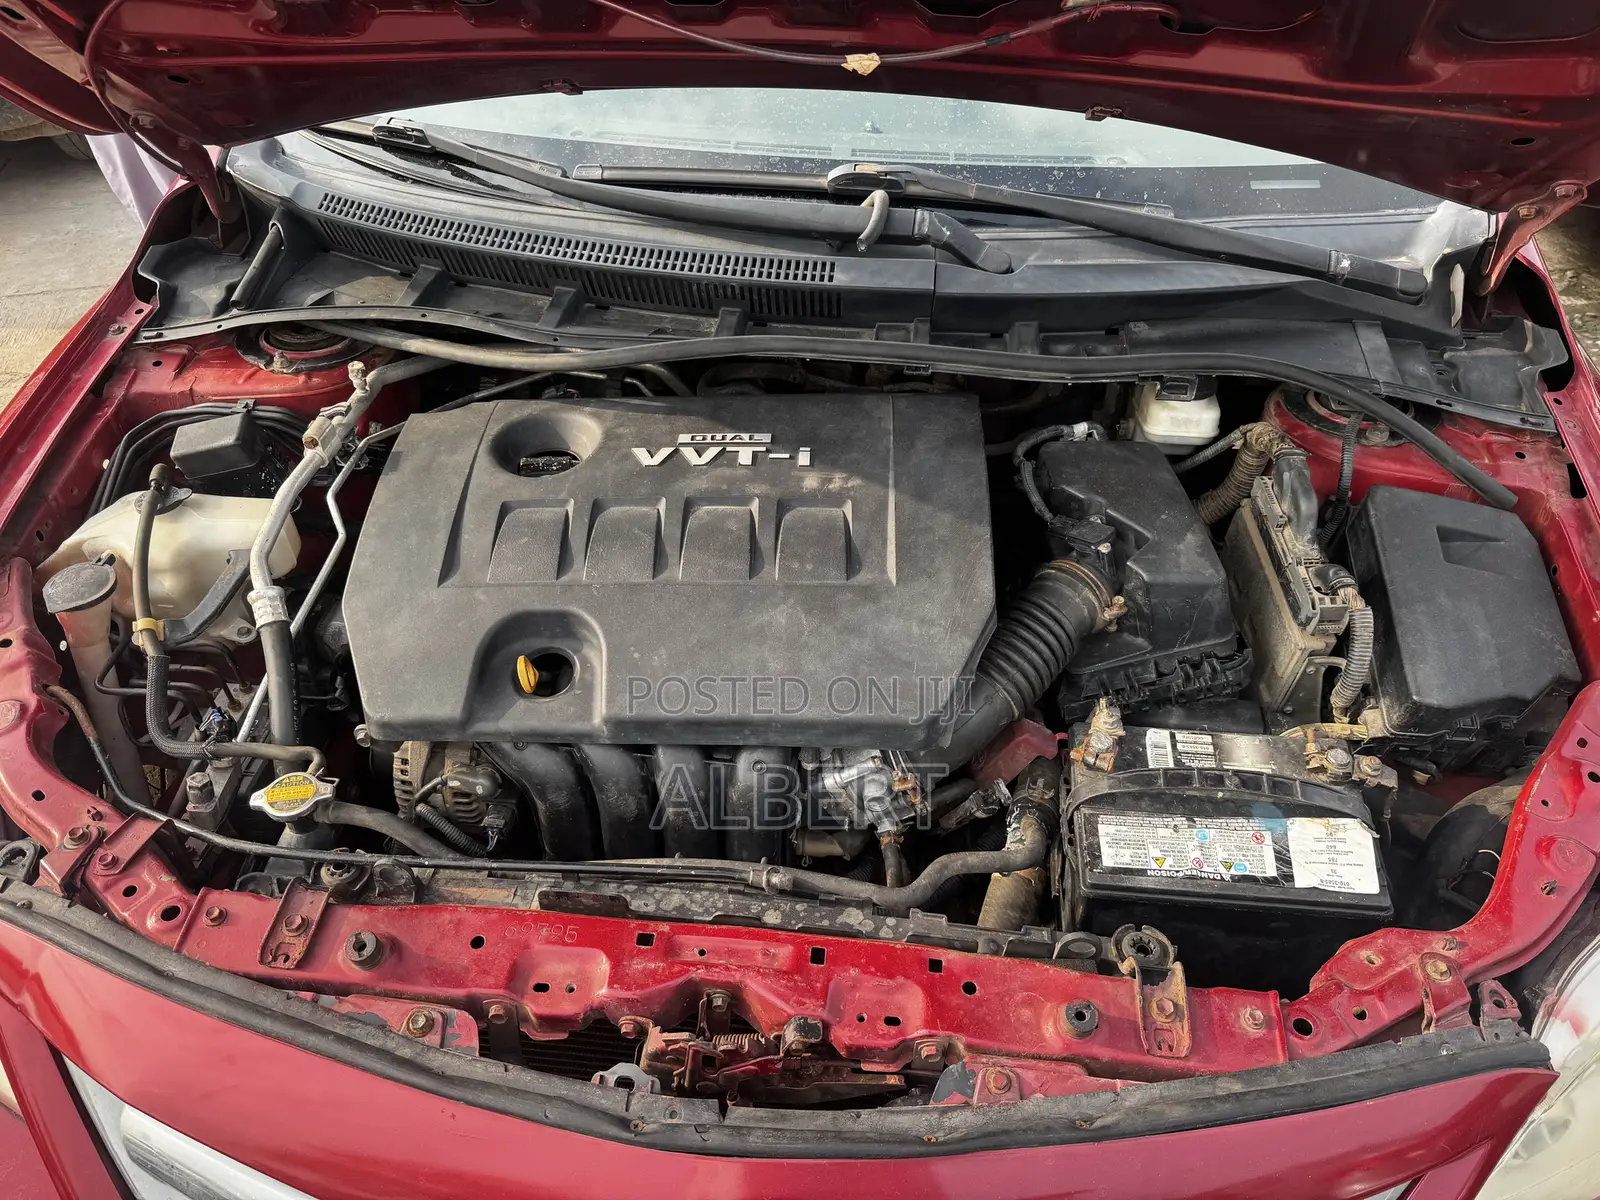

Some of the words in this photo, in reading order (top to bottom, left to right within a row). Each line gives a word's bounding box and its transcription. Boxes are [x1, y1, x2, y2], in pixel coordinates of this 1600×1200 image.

[689, 434, 764, 442] DUAL
[631, 447, 811, 467] VVT-i
[275, 780, 310, 788] CAUTION
